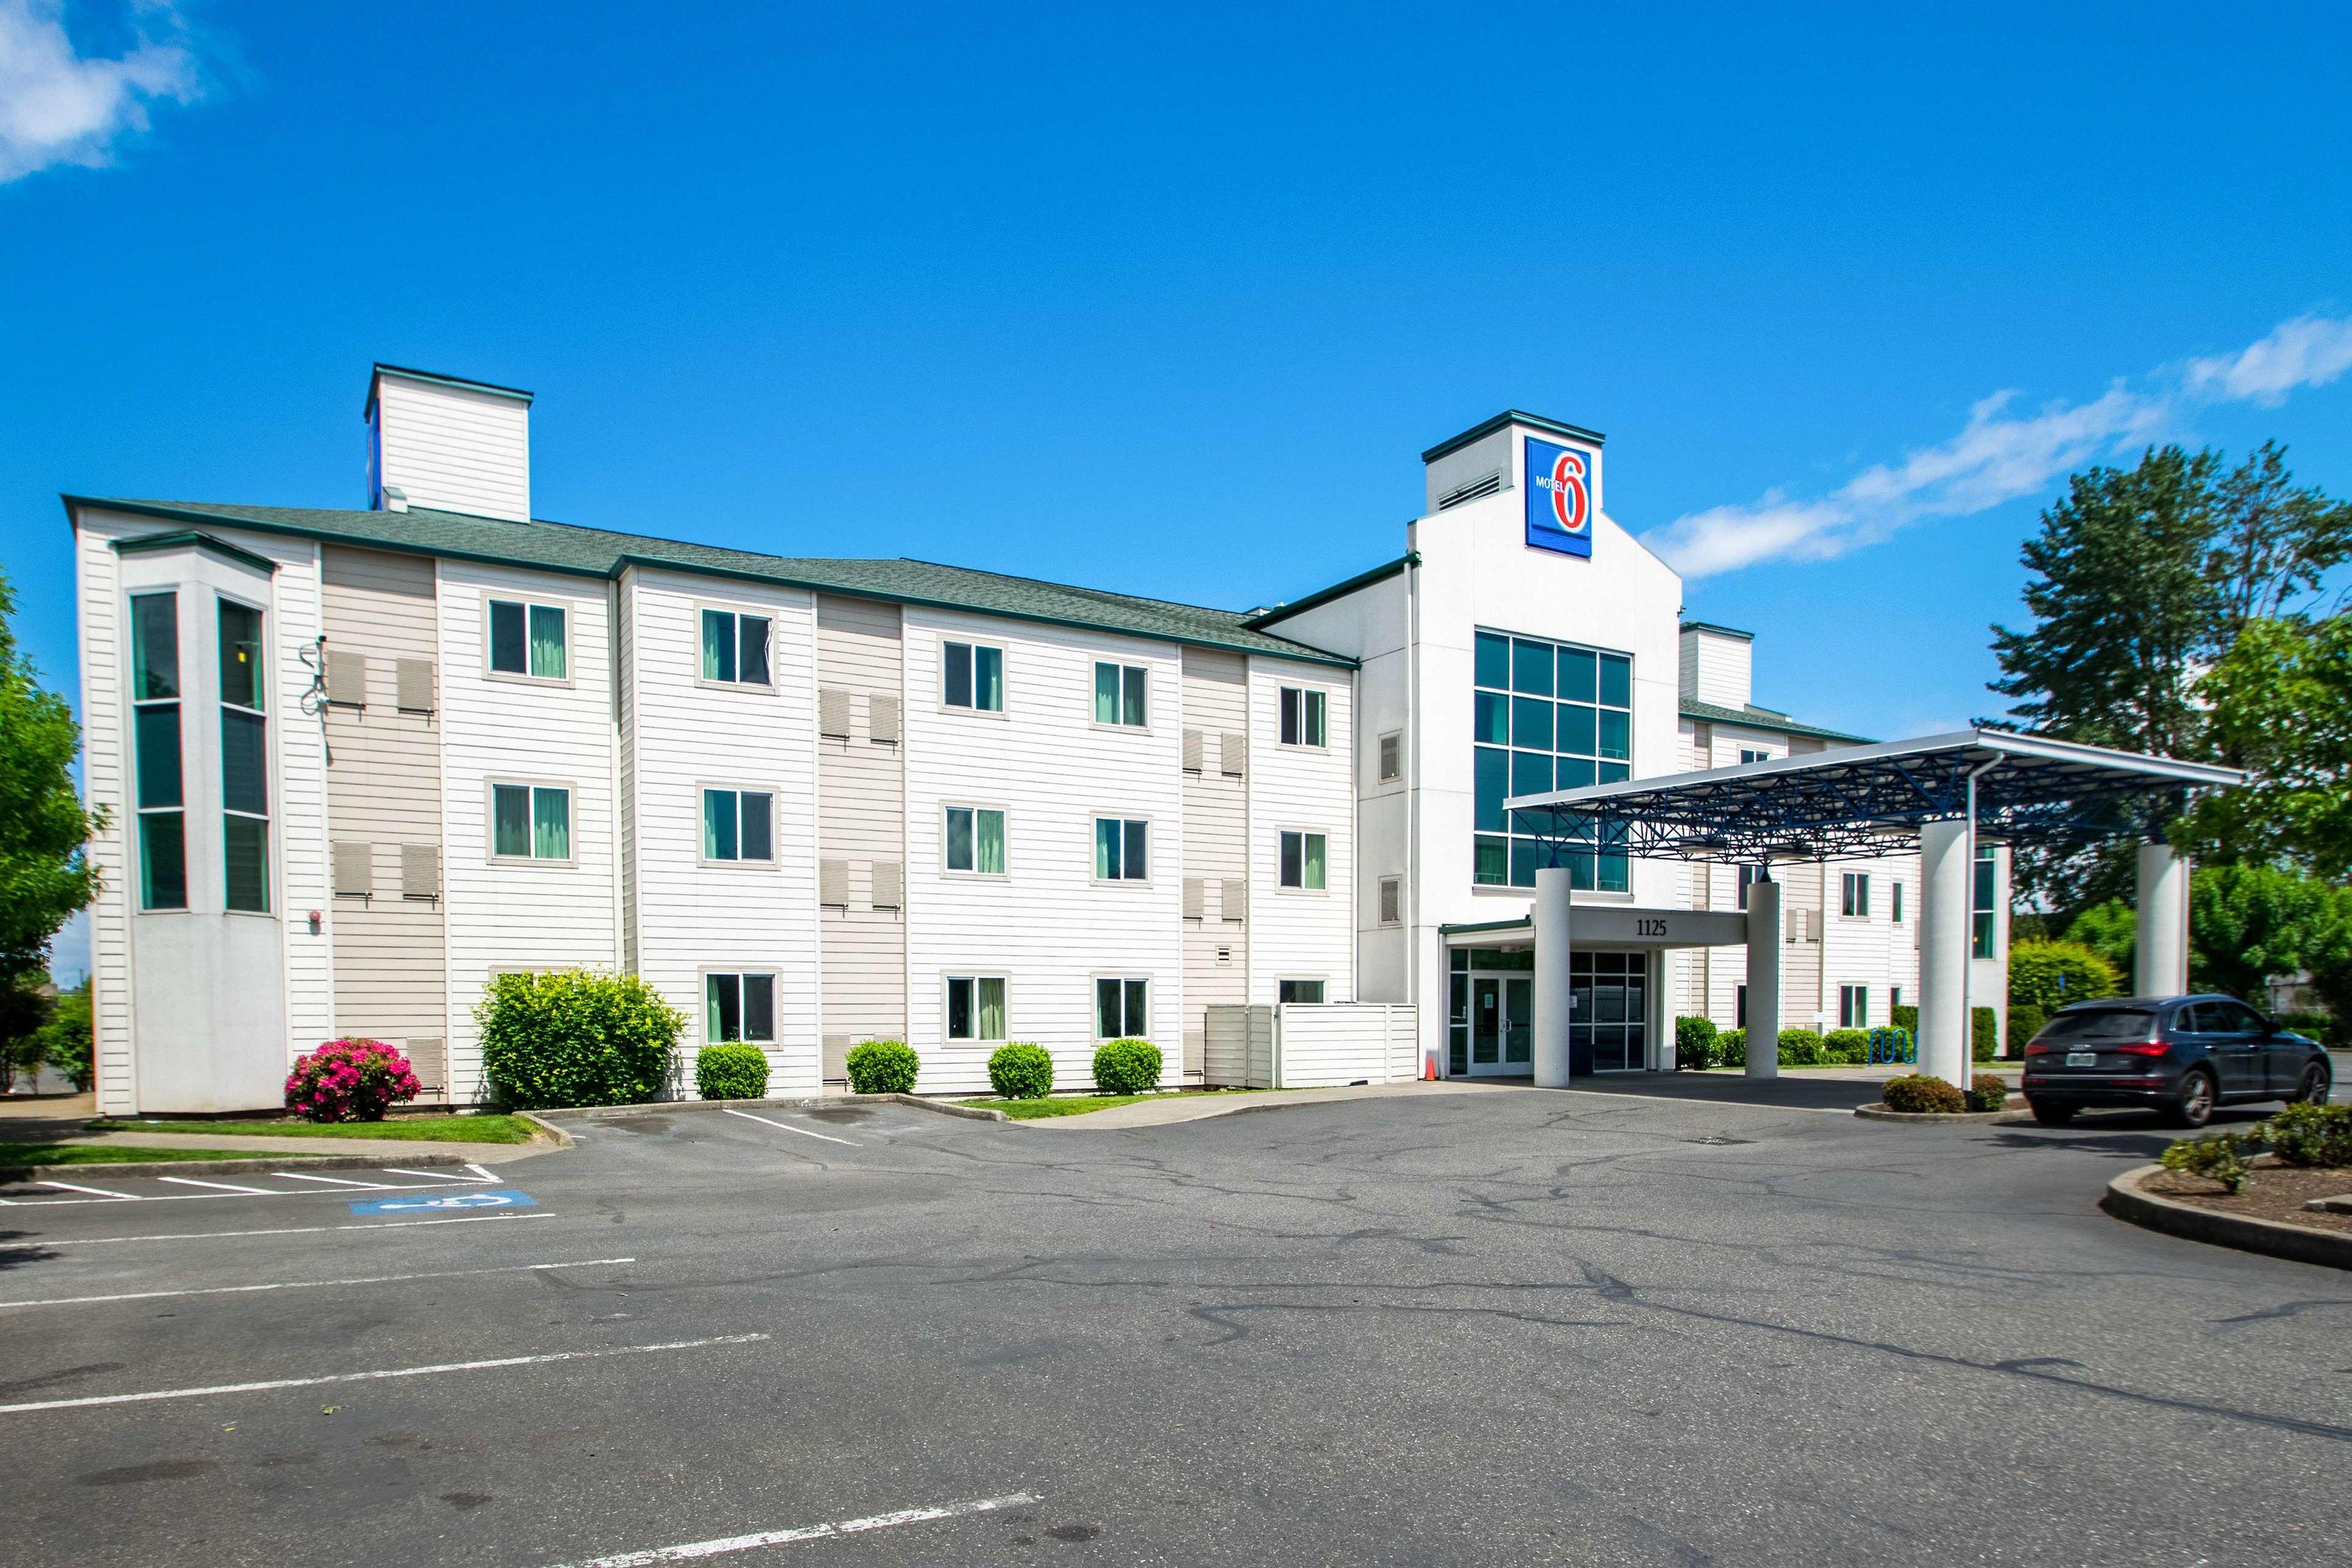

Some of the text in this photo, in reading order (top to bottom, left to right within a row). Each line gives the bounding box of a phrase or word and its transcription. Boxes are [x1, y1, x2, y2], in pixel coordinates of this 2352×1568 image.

[1535, 453, 1588, 531] MOTEL 6
[1637, 919, 1667, 936] 1125
